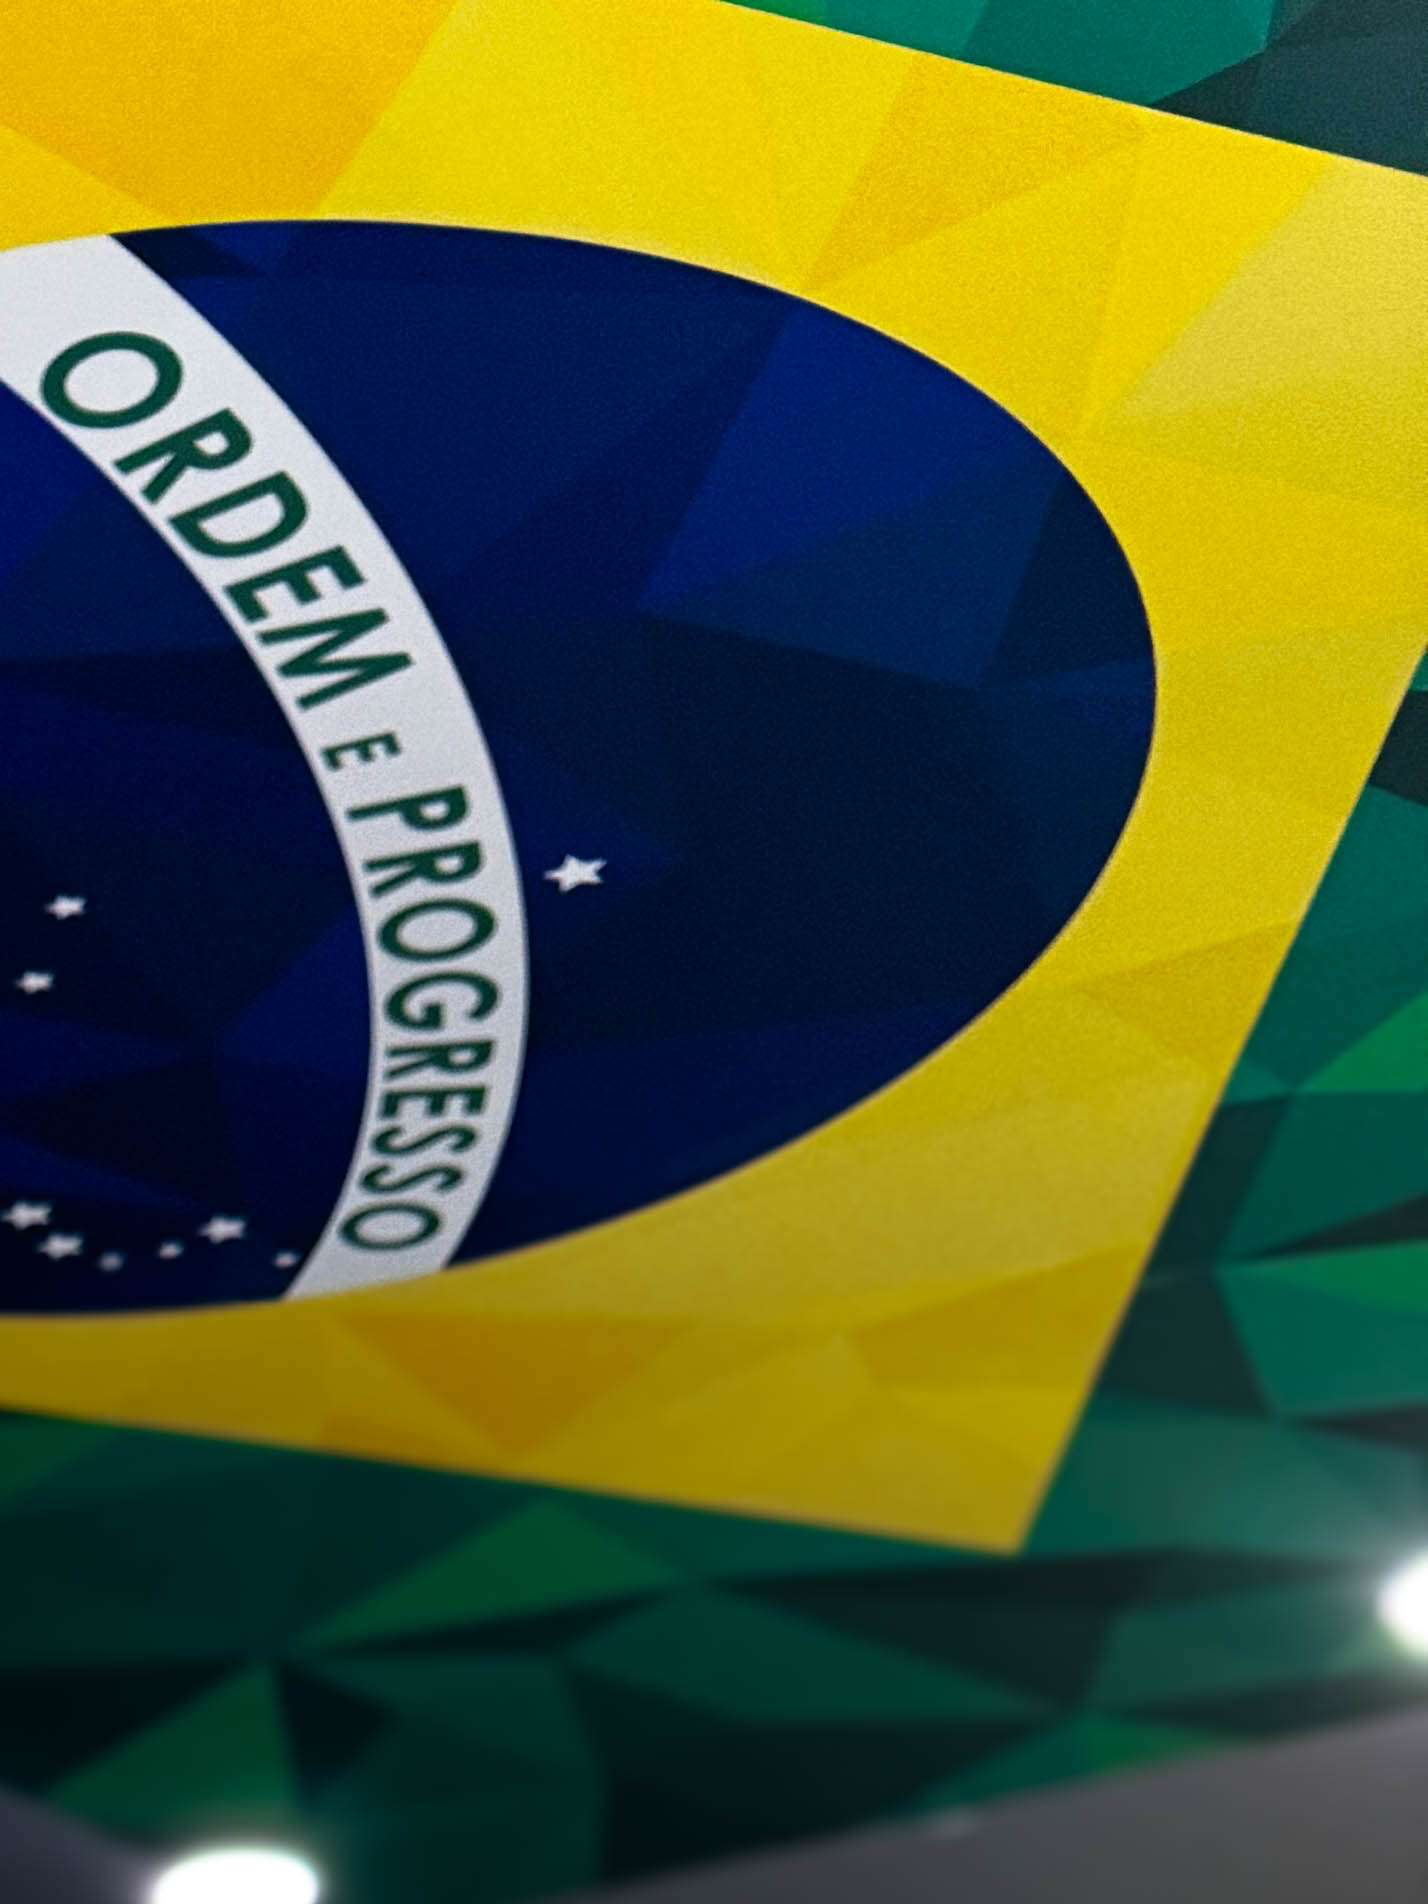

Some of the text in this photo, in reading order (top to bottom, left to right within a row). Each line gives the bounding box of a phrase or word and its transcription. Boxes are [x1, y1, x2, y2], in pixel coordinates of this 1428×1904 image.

[40, 331, 502, 1251] ORDEM E PROGRESSO
